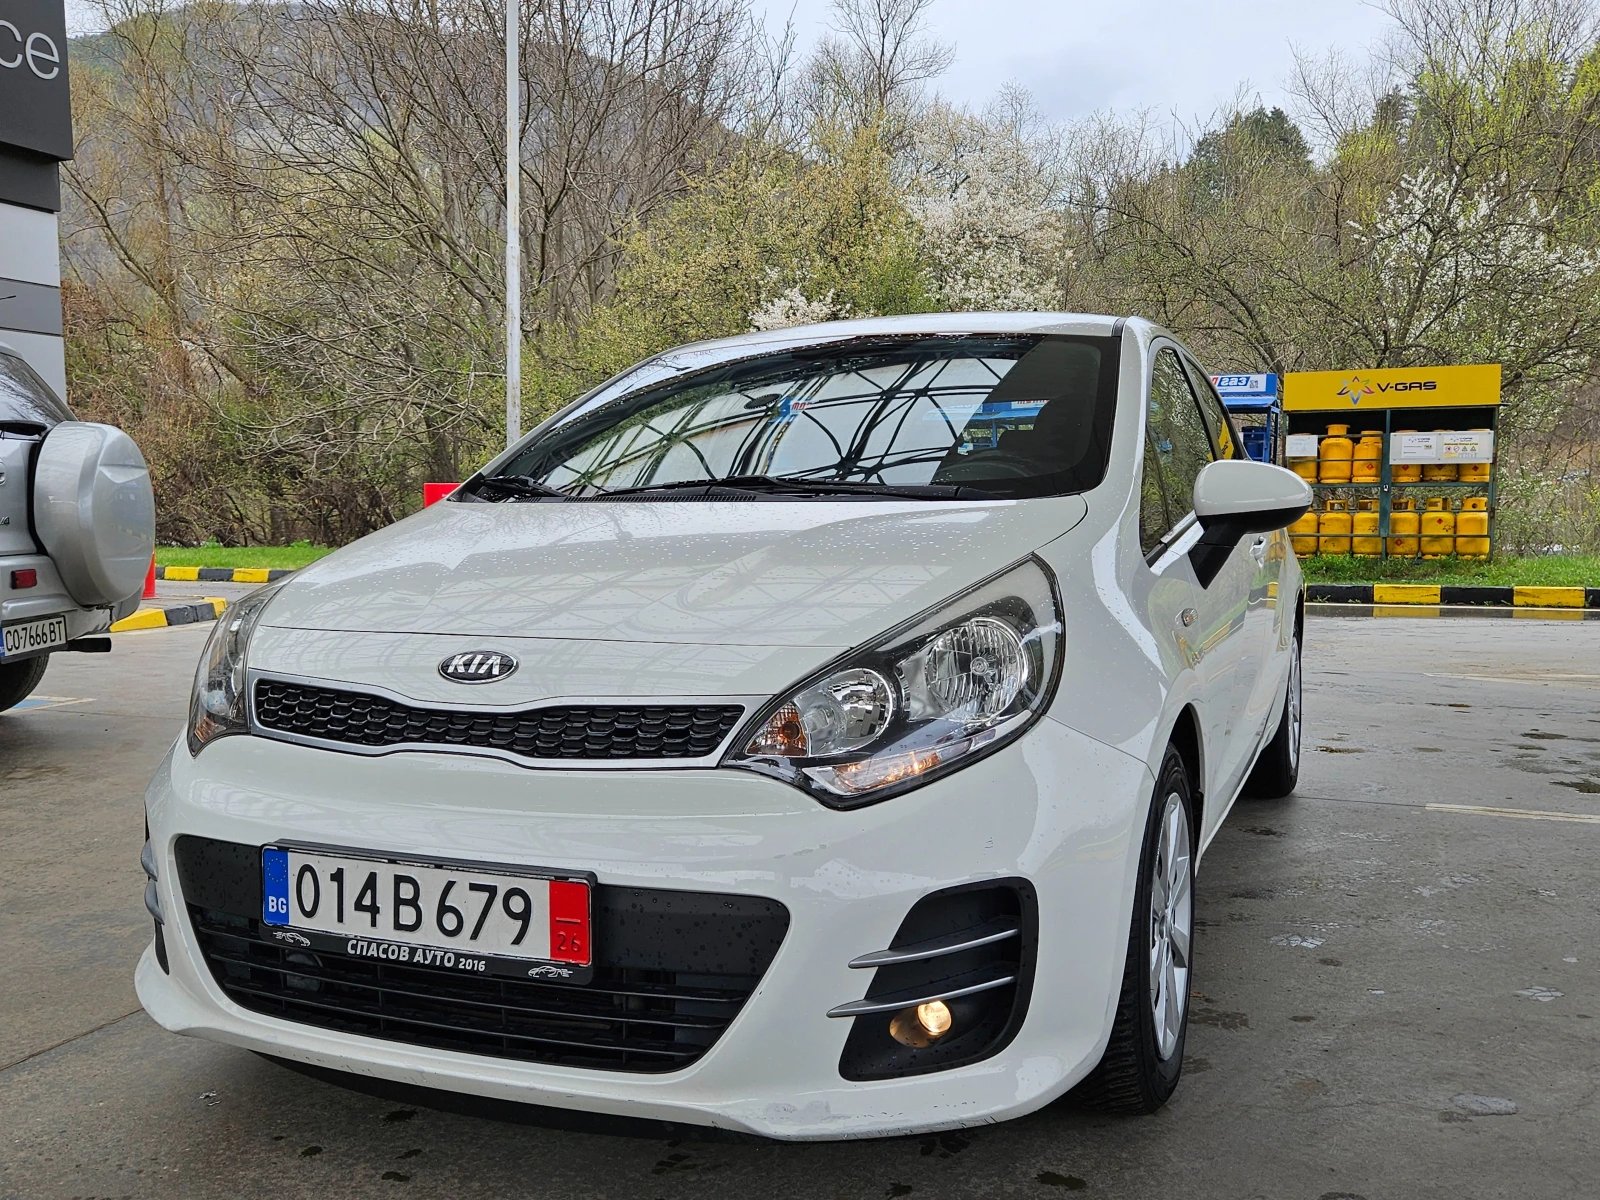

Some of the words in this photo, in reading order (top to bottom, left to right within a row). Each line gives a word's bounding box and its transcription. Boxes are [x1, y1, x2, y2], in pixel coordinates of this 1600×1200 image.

[1376, 381, 1437, 393] V-GAS
[447, 654, 502, 676] KIA
[268, 895, 287, 914] BG
[557, 930, 582, 953] 26
[347, 939, 410, 961] СПАСОВ
[412, 948, 455, 968] АУТО
[458, 957, 486, 972] 2016
